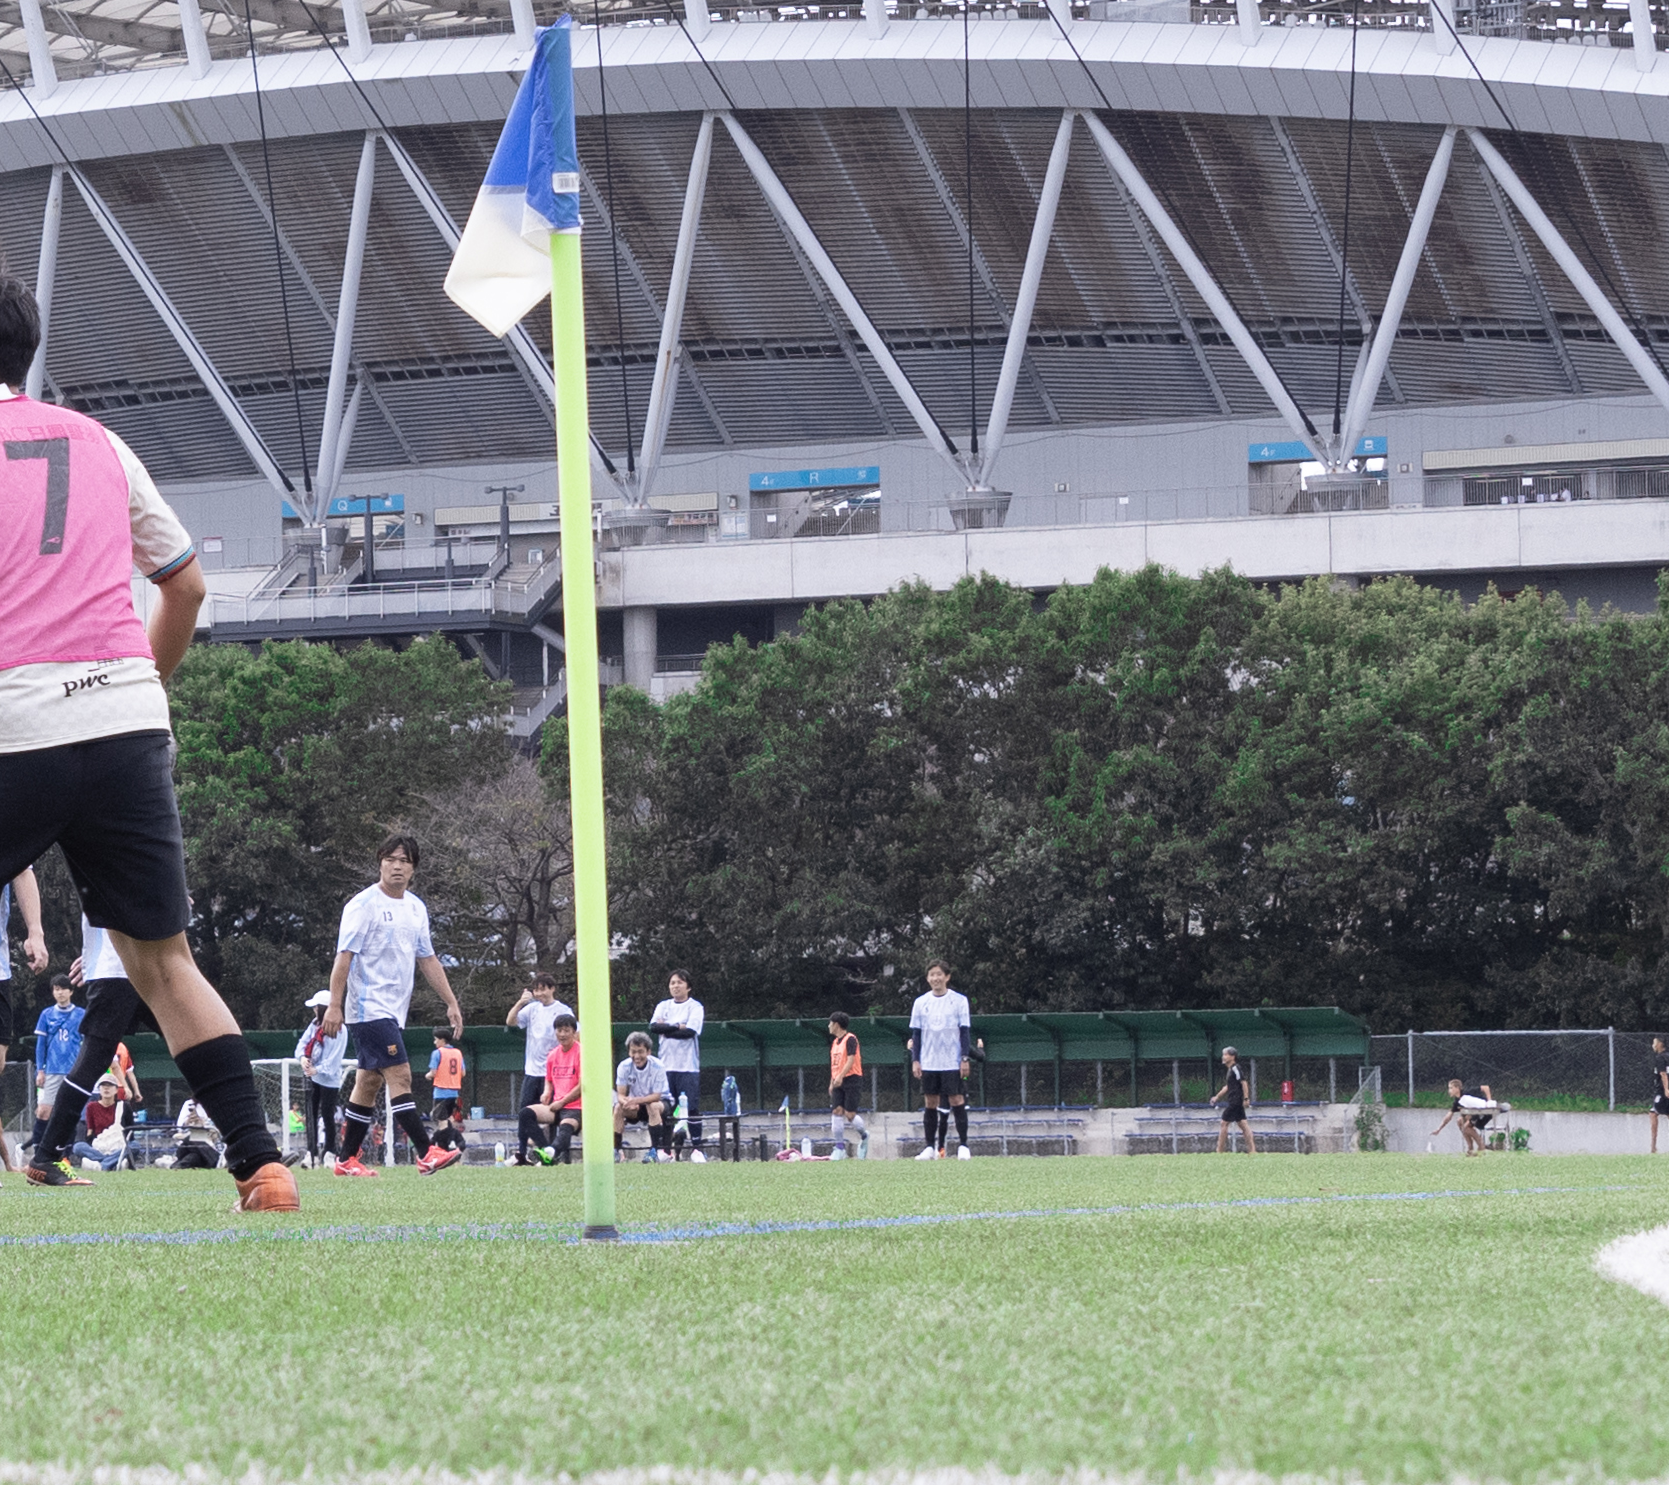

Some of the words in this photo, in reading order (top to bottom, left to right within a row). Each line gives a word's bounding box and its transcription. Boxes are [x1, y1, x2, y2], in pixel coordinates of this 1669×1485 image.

[3, 437, 70, 555] 7
[62, 674, 110, 697] pwc
[383, 910, 394, 923] 13
[449, 1058, 458, 1076] 8
